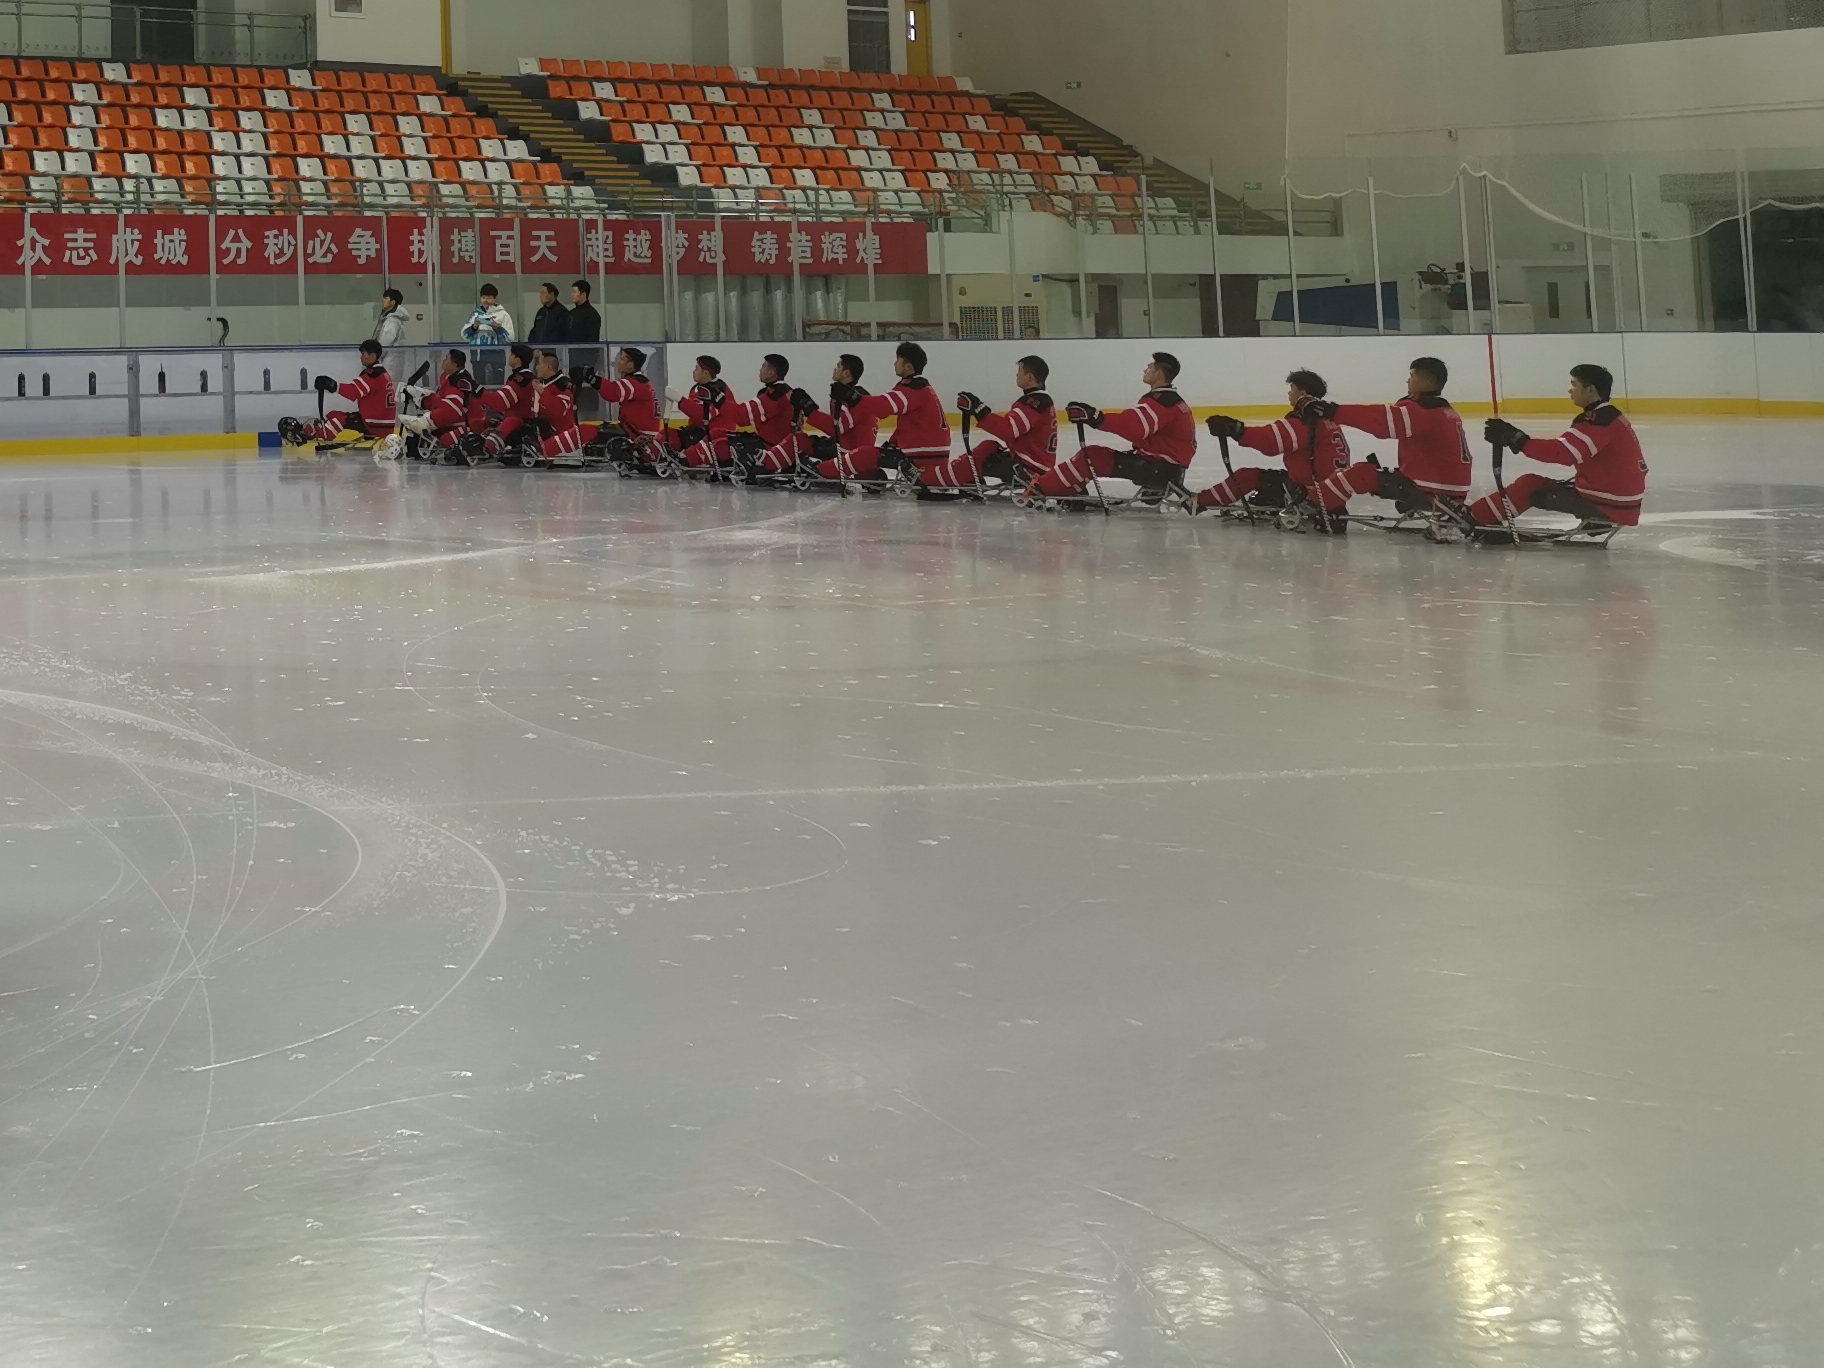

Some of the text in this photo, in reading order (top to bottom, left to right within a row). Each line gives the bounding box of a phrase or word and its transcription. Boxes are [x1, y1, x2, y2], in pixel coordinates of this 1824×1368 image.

[16, 227, 189, 266] 众志成城
[220, 227, 380, 265] 分秒必争
[750, 230, 882, 265] 铸造辉煌
